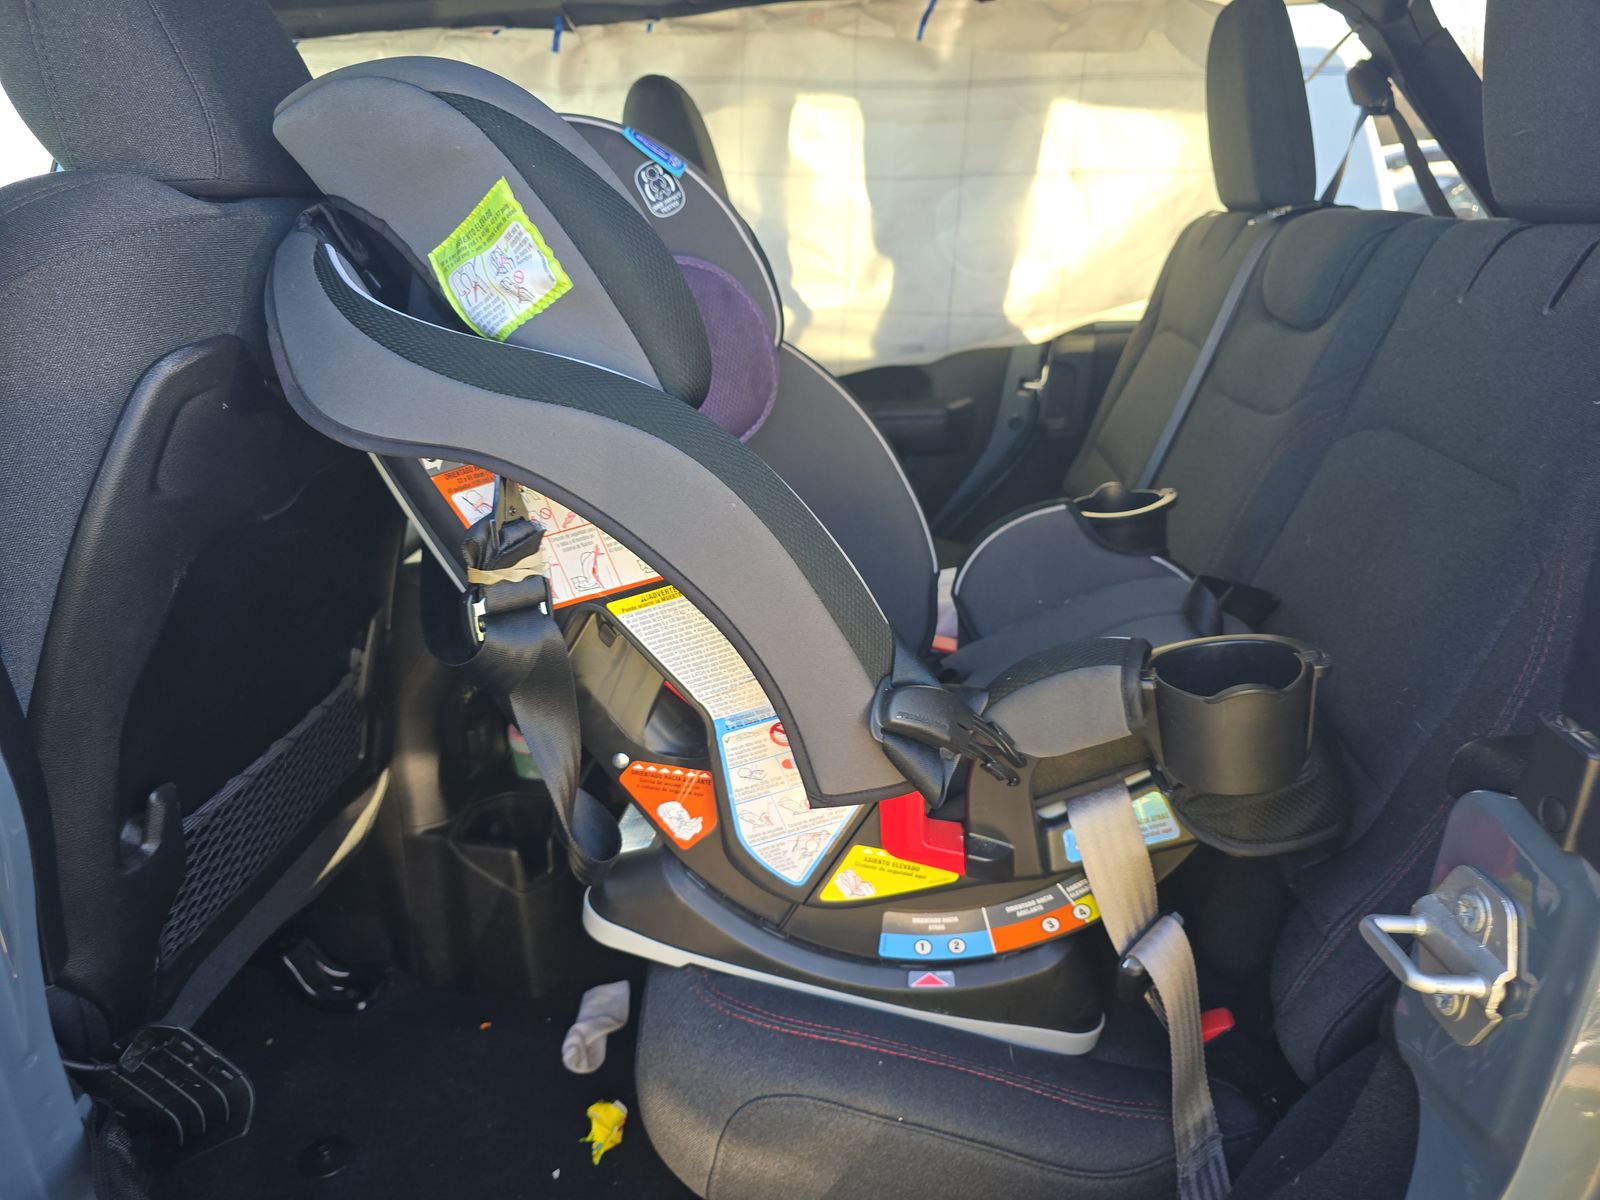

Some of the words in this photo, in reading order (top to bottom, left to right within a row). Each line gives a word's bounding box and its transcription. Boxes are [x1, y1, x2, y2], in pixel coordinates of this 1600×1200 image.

[863, 857, 890, 867] ASIENTO
[891, 861, 920, 872] ELEVADO
[887, 867, 913, 878] seguridad
[1079, 908, 1087, 916] 4
[1047, 920, 1055, 929] 3
[920, 942, 925, 951] 1
[954, 941, 960, 950] 2
